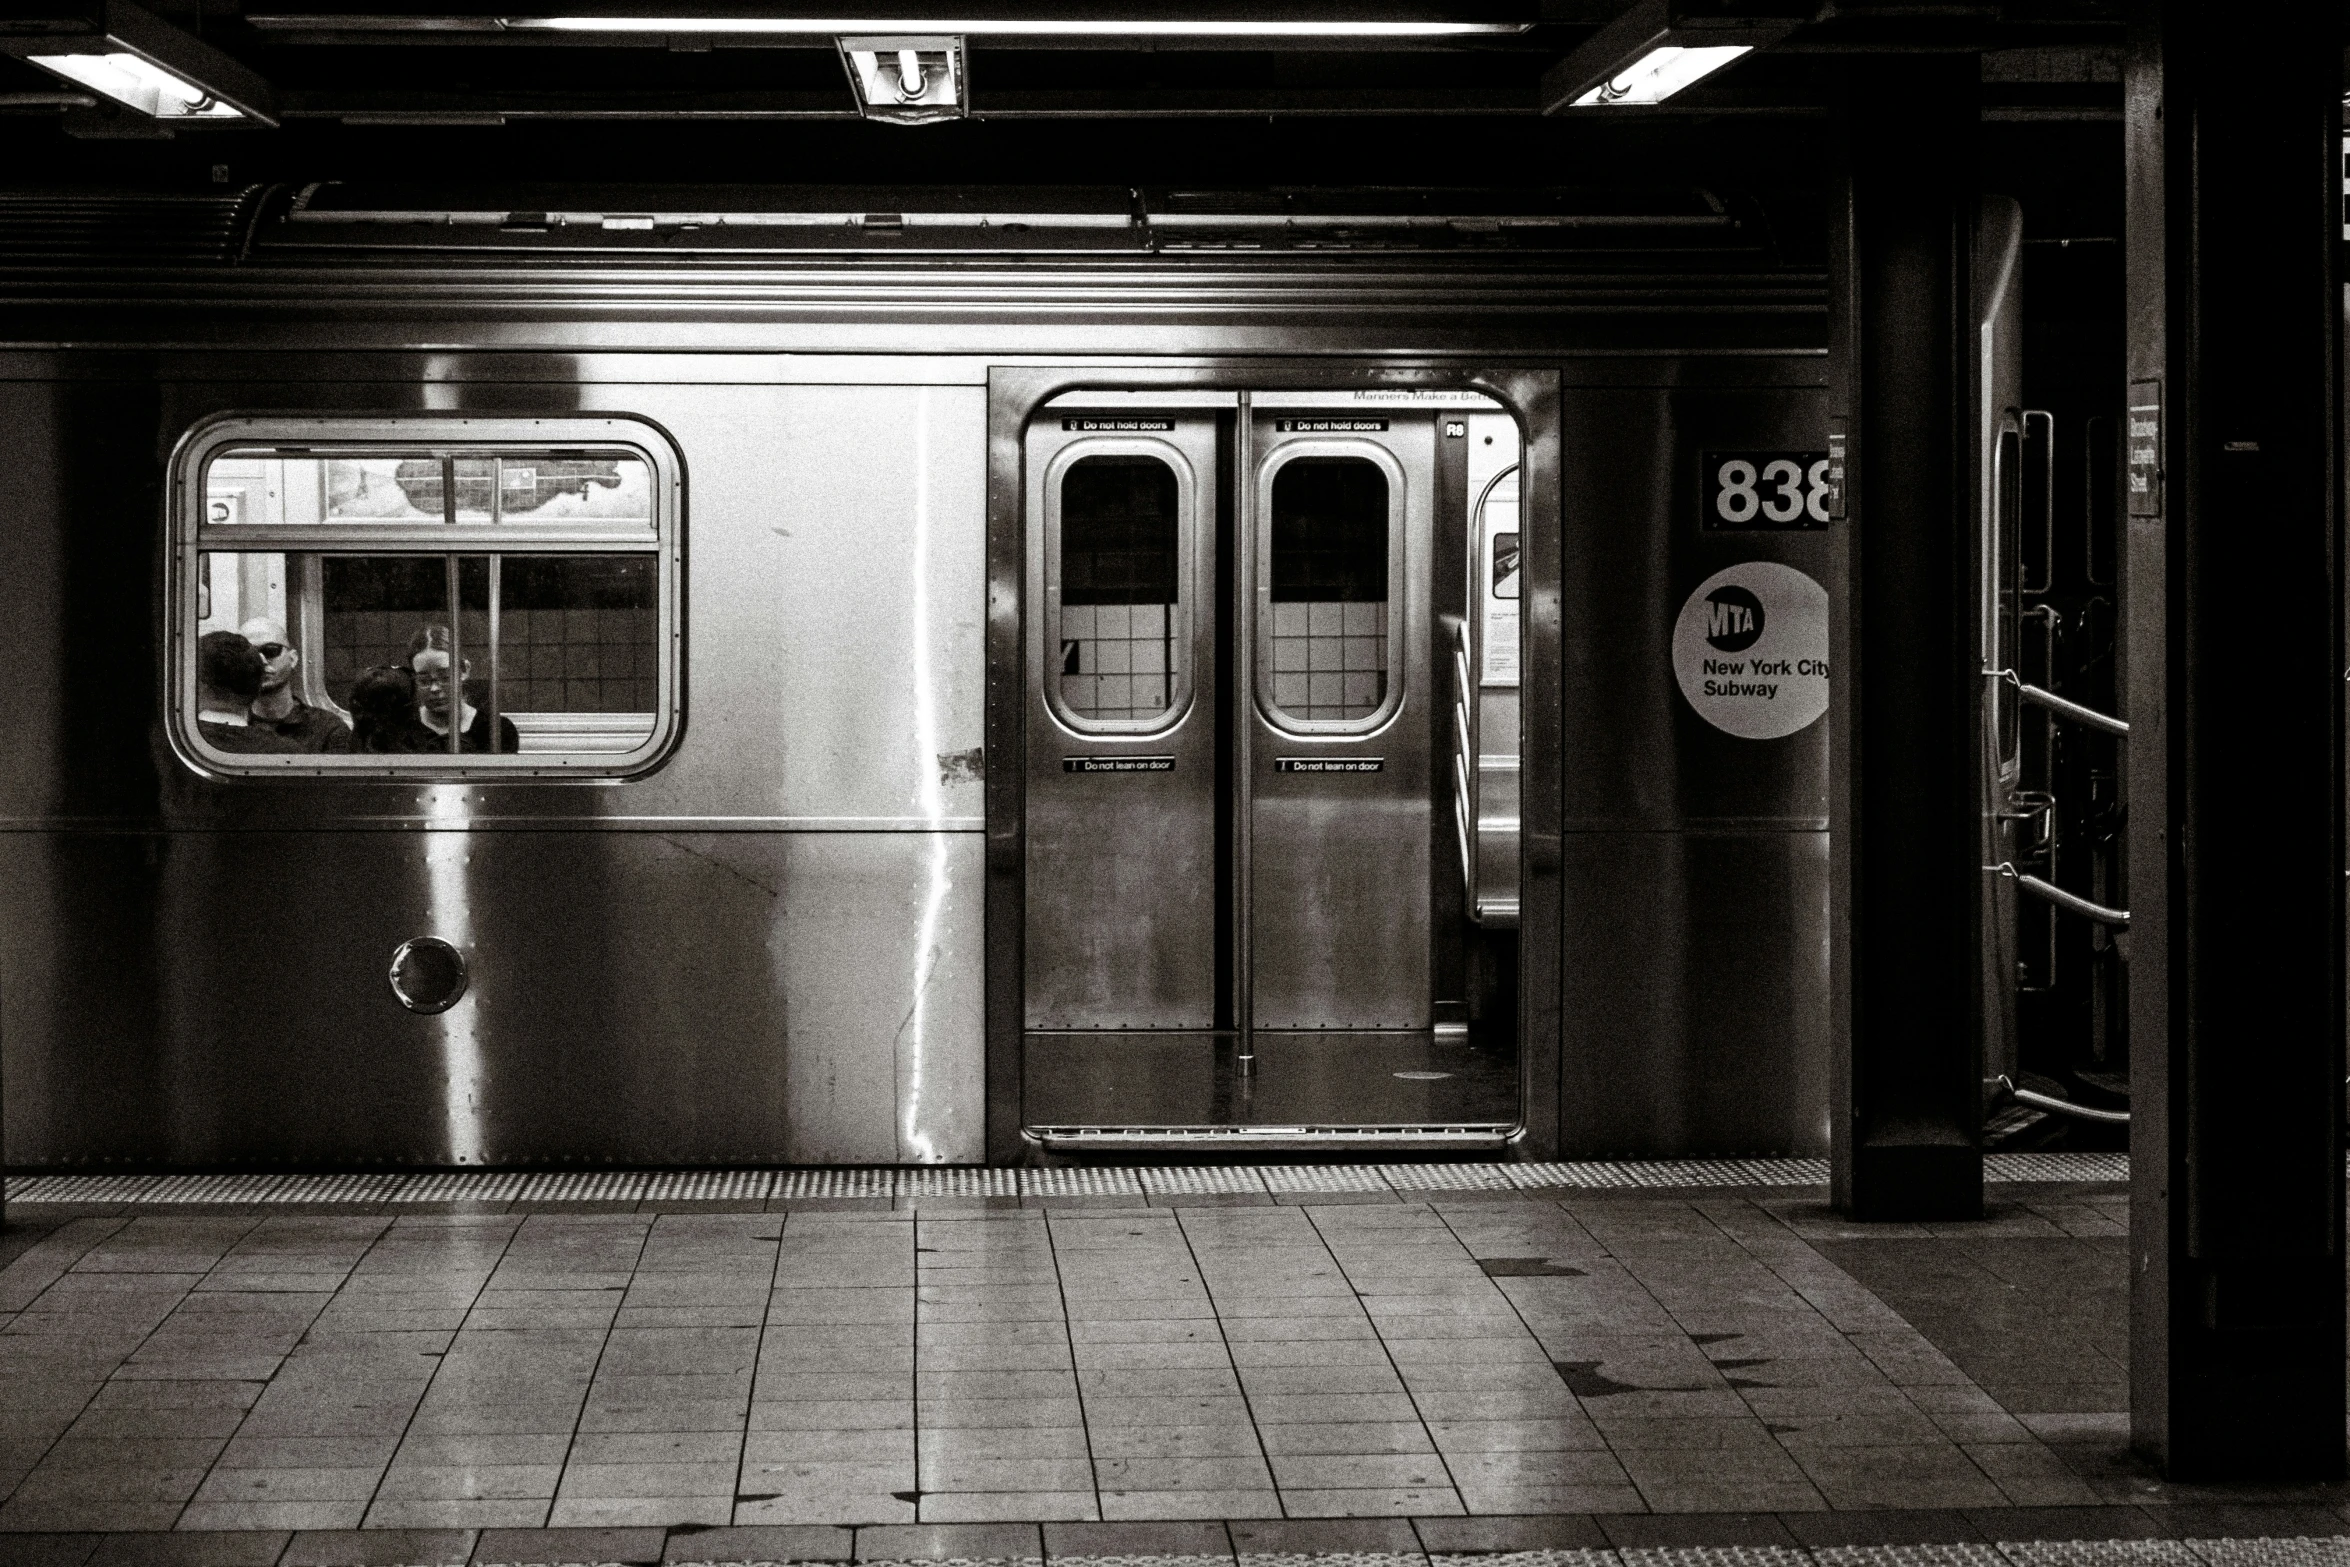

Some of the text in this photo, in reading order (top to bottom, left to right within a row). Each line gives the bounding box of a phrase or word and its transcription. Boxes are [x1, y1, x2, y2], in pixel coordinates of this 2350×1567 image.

[1354, 390, 1409, 400] Manners
[1413, 390, 1447, 400] Make
[1083, 421, 1168, 430] Do not hold doors
[1297, 421, 1382, 431] Do not hold doors
[1446, 423, 1464, 437] R8
[1704, 600, 1754, 638] MTA
[1703, 659, 1829, 680] New York City
[1703, 680, 1778, 700] Subway
[1084, 761, 1098, 770] Do
[1099, 761, 1114, 770] not
[1116, 761, 1136, 770] lean
[1149, 761, 1170, 769] door
[1293, 761, 1307, 771] Do
[1308, 762, 1323, 770] not
[1325, 762, 1345, 770] lean
[1358, 762, 1379, 770] door
